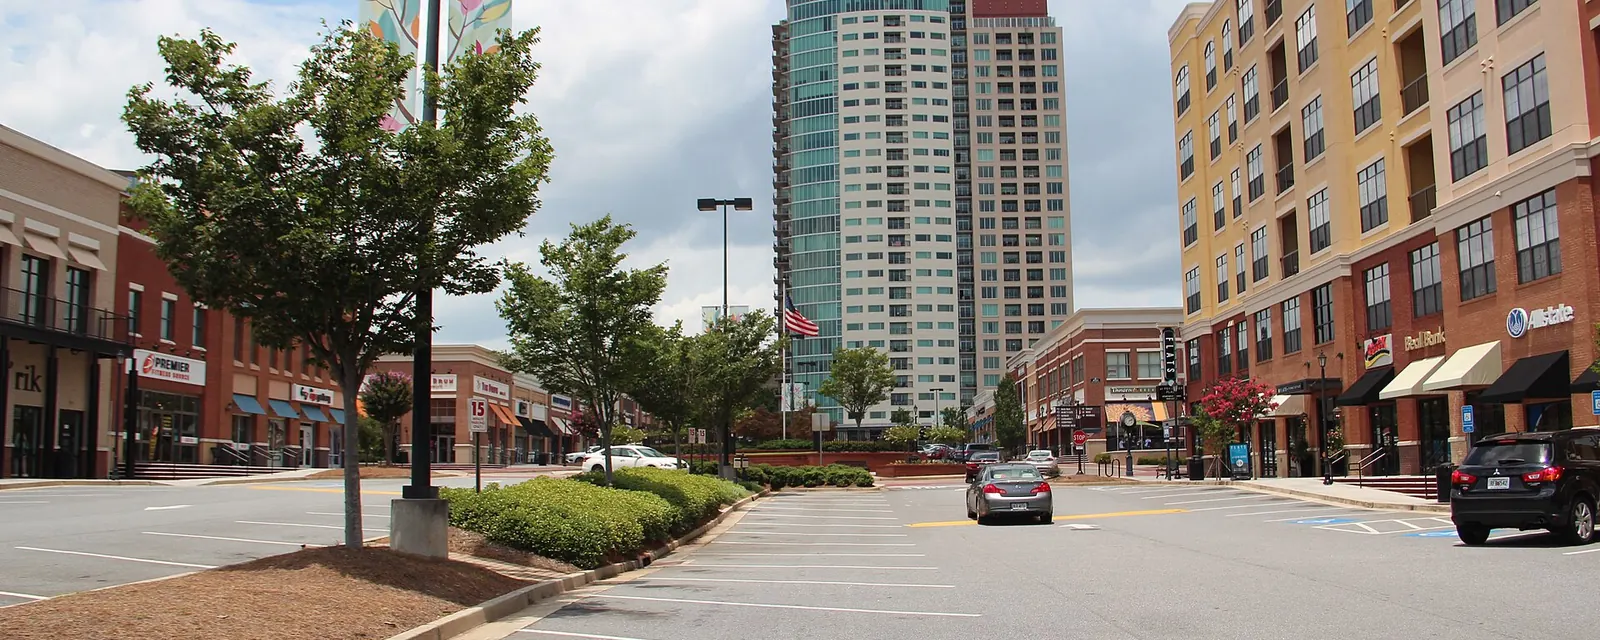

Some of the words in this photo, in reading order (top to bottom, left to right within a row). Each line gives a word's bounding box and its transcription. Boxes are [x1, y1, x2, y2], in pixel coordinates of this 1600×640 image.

[1527, 303, 1575, 330] Allstate
[1424, 326, 1446, 347] Bank
[155, 357, 189, 373] PREMIER
[1165, 337, 1175, 373] FLATS
[9, 361, 42, 392] rik
[472, 401, 485, 416] 15
